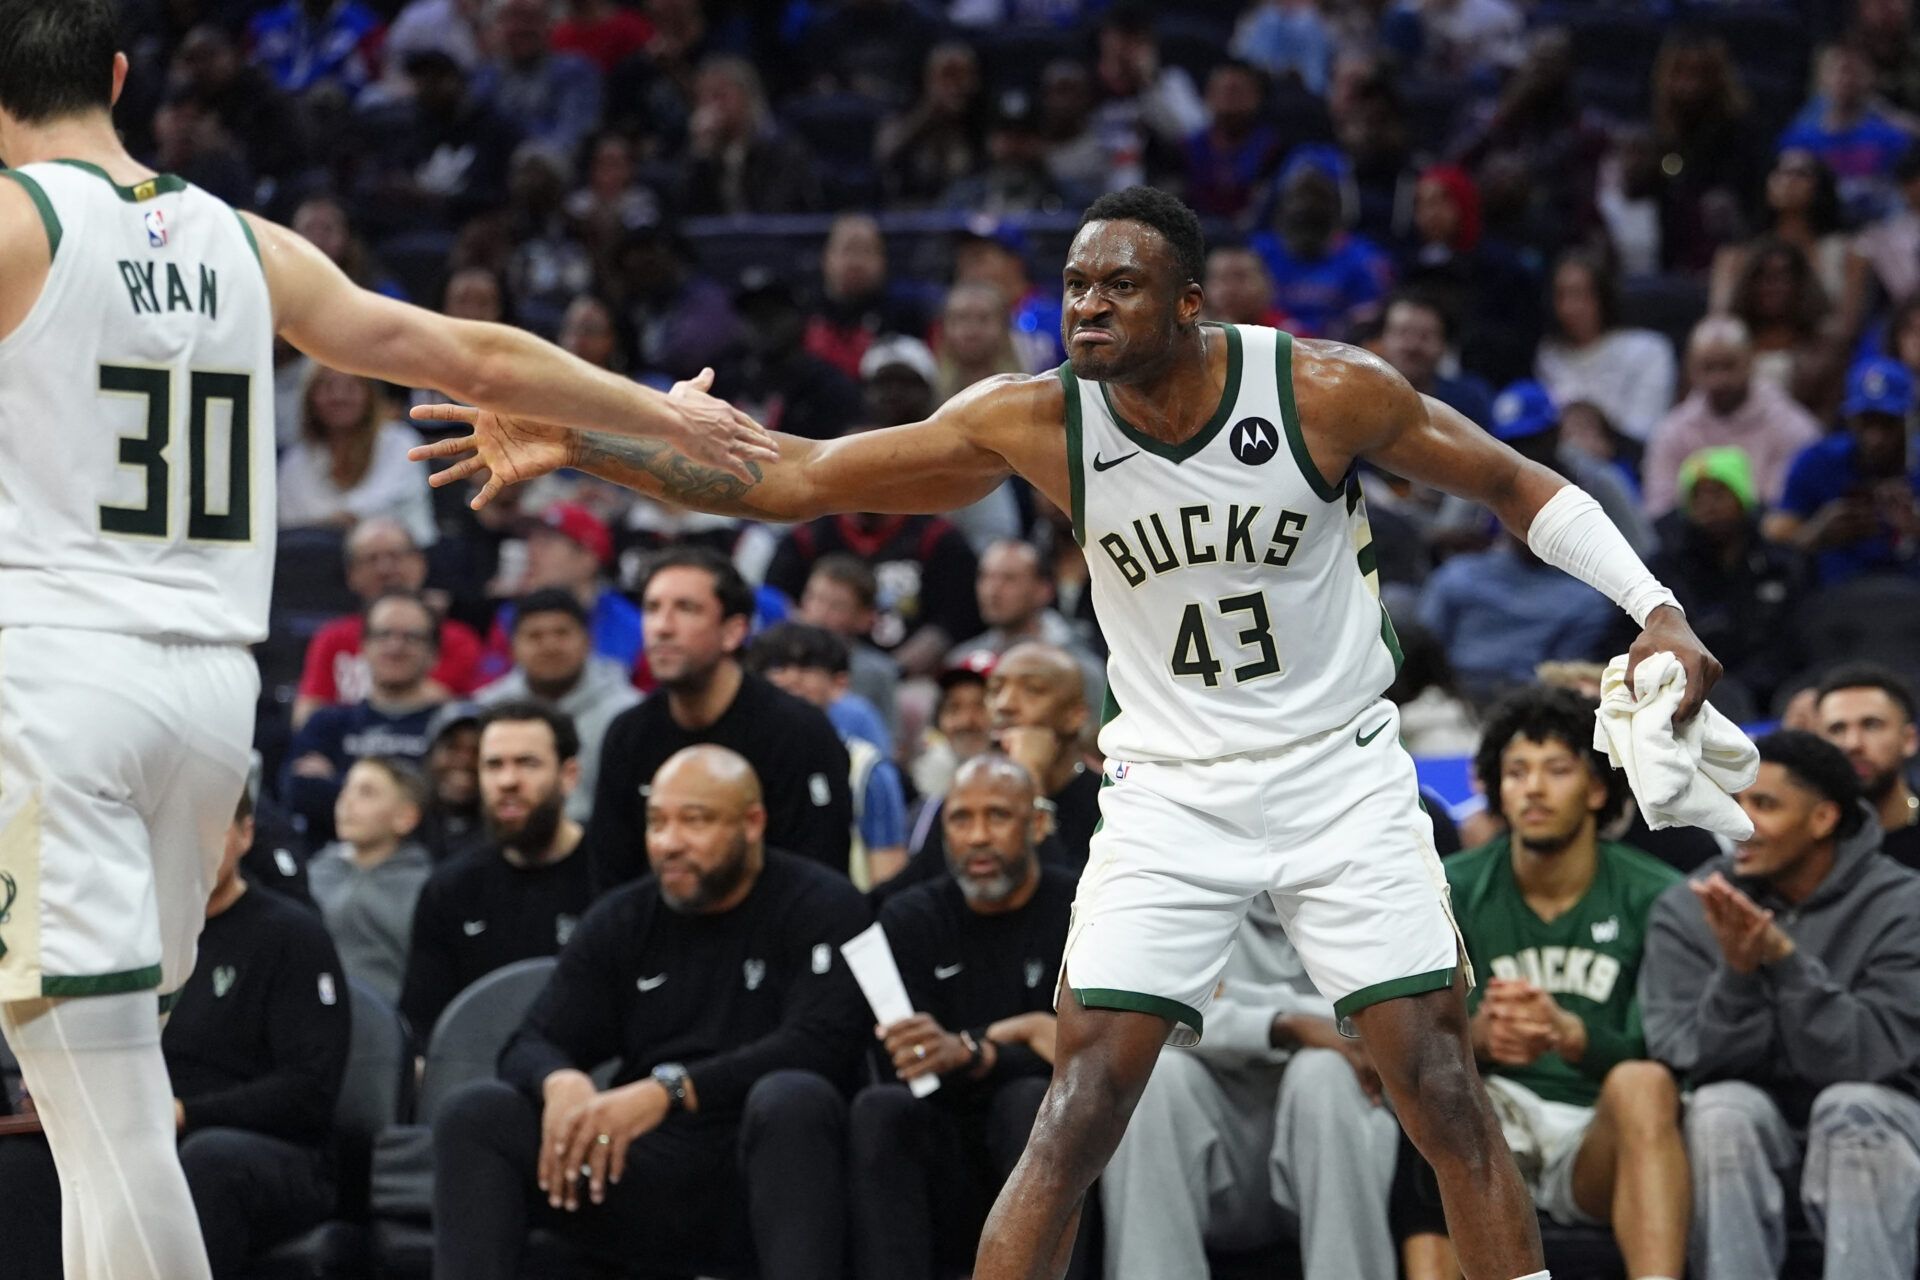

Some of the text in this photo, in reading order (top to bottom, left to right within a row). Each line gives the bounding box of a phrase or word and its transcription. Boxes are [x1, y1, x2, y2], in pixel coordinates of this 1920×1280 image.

[117, 260, 217, 320] RYAN
[98, 363, 252, 543] 30
[1098, 503, 1309, 588] BUCKS
[1170, 589, 1282, 688] 43
